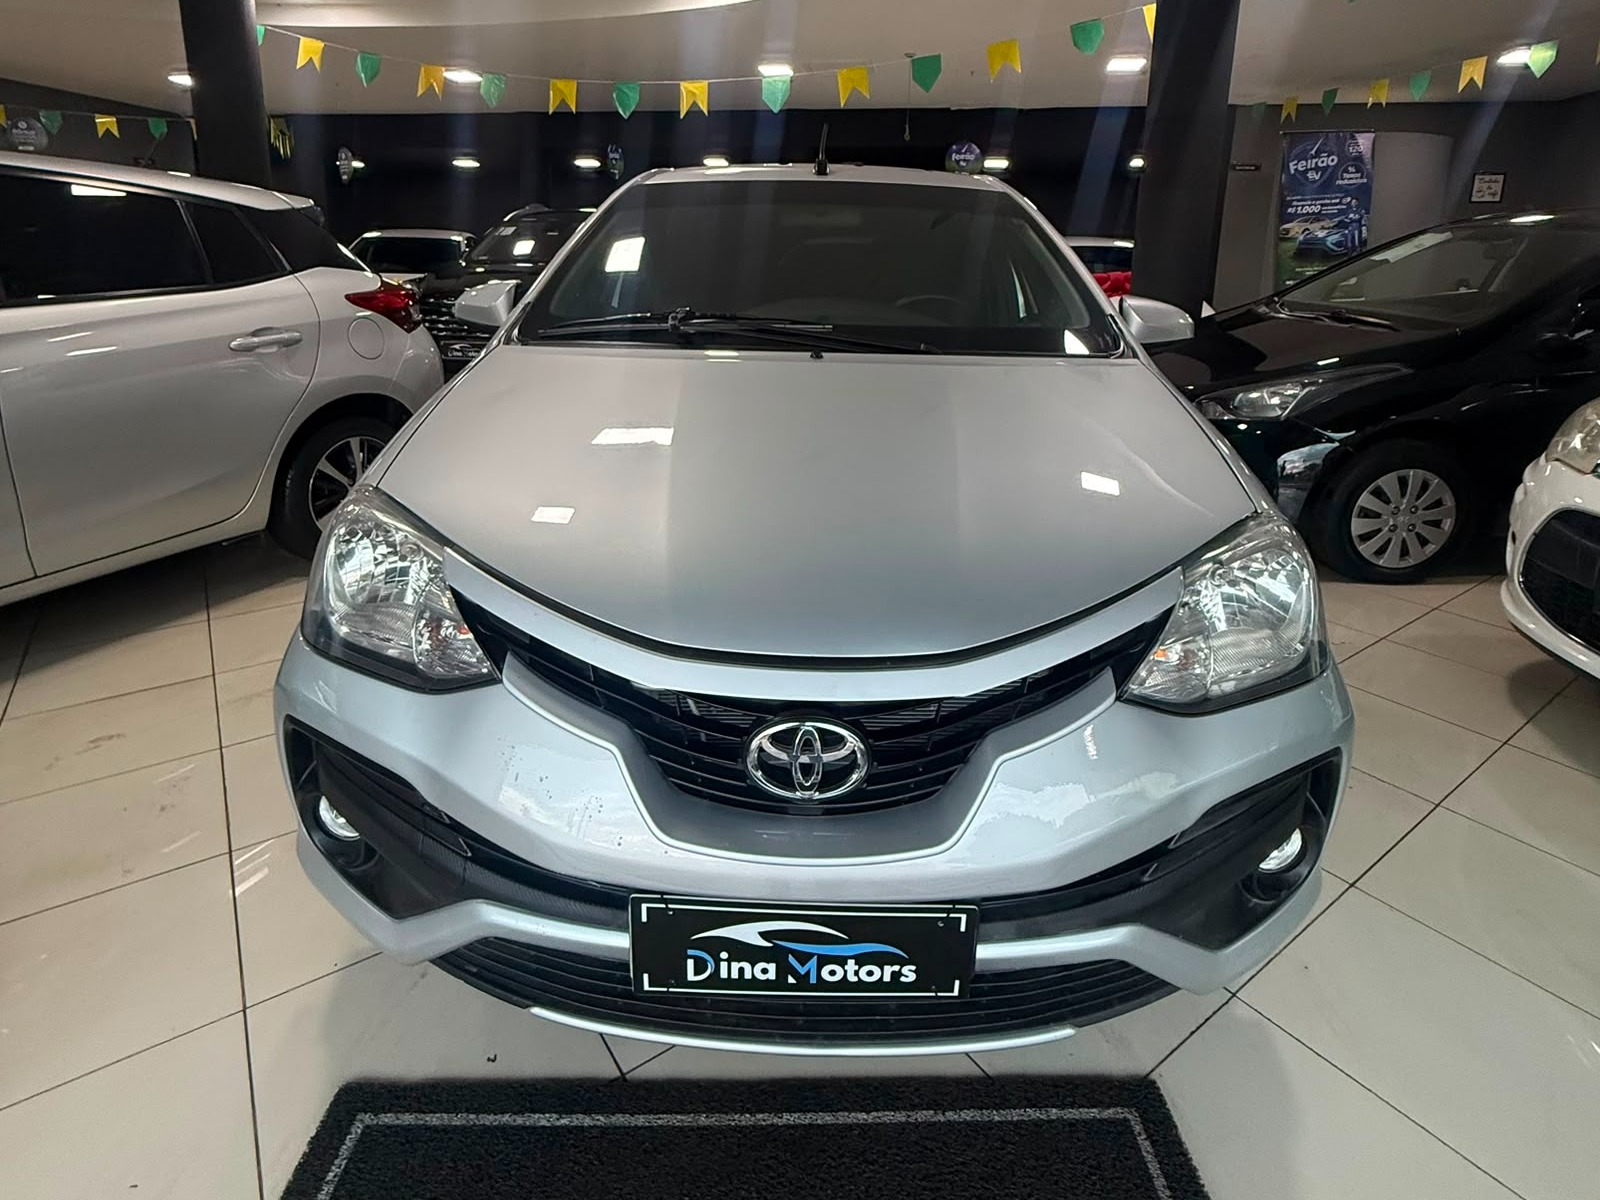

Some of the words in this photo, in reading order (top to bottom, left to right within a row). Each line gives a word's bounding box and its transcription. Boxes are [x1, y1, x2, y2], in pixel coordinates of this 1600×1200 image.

[1288, 152, 1338, 174] Feirão
[1296, 205, 1321, 214] 1.000
[686, 948, 777, 982] Dina
[787, 952, 918, 985] Motors
